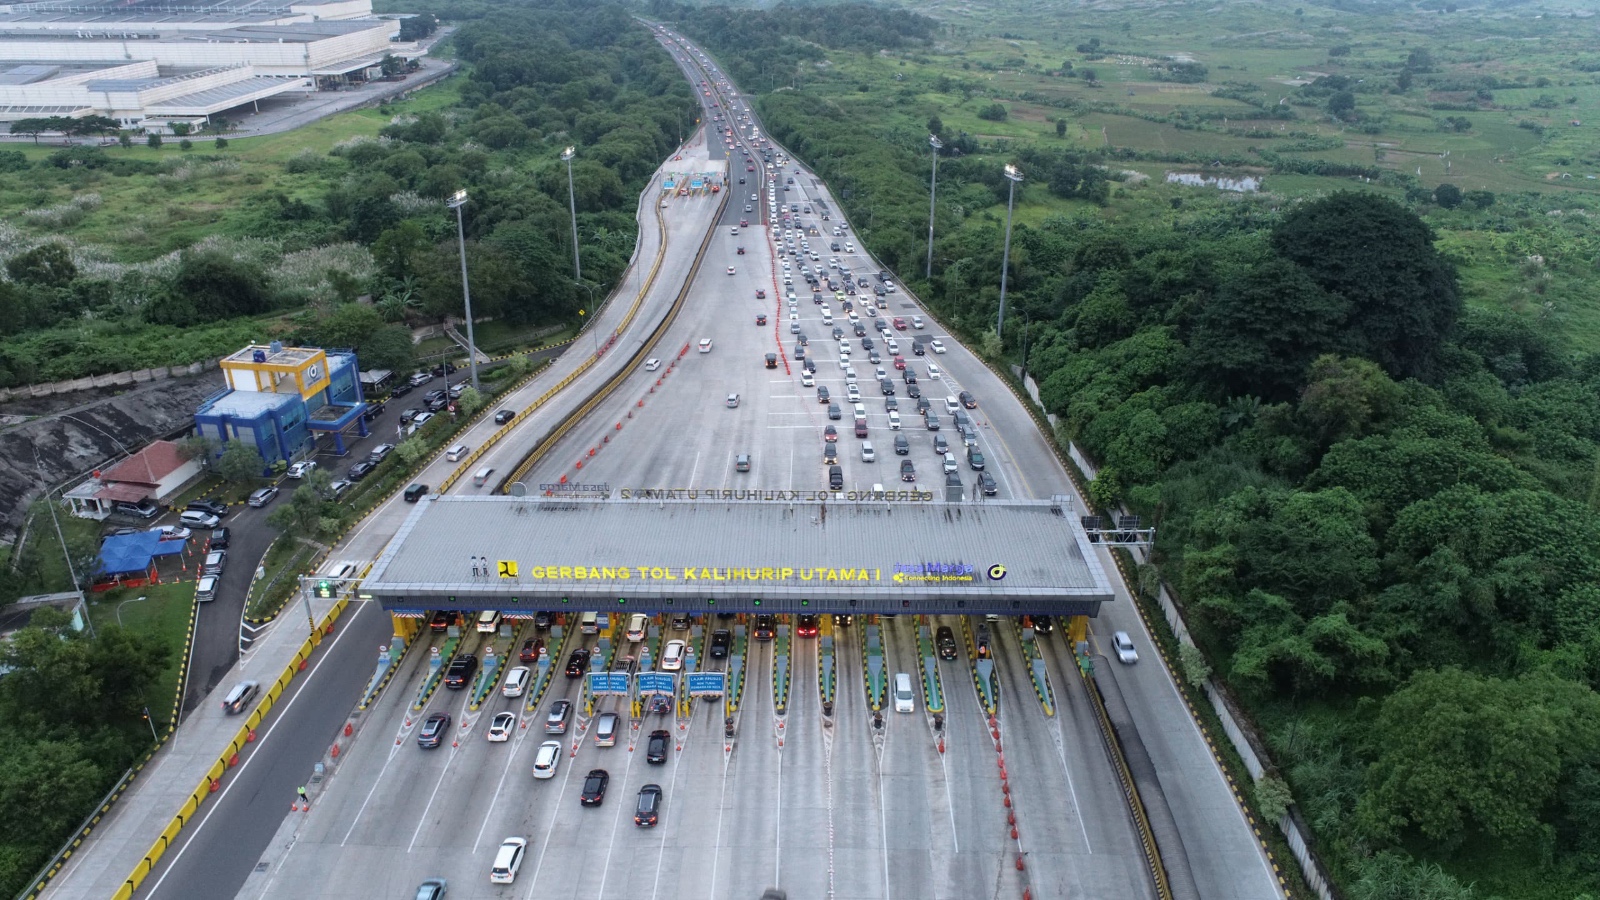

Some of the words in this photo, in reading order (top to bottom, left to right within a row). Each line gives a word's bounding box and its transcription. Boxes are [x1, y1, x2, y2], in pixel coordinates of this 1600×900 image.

[532, 566, 631, 579] GERBANG
[637, 566, 677, 579] TOL
[684, 567, 794, 580] KALIHURIP
[799, 568, 870, 580] UTAMA
[927, 562, 974, 575] Marga
